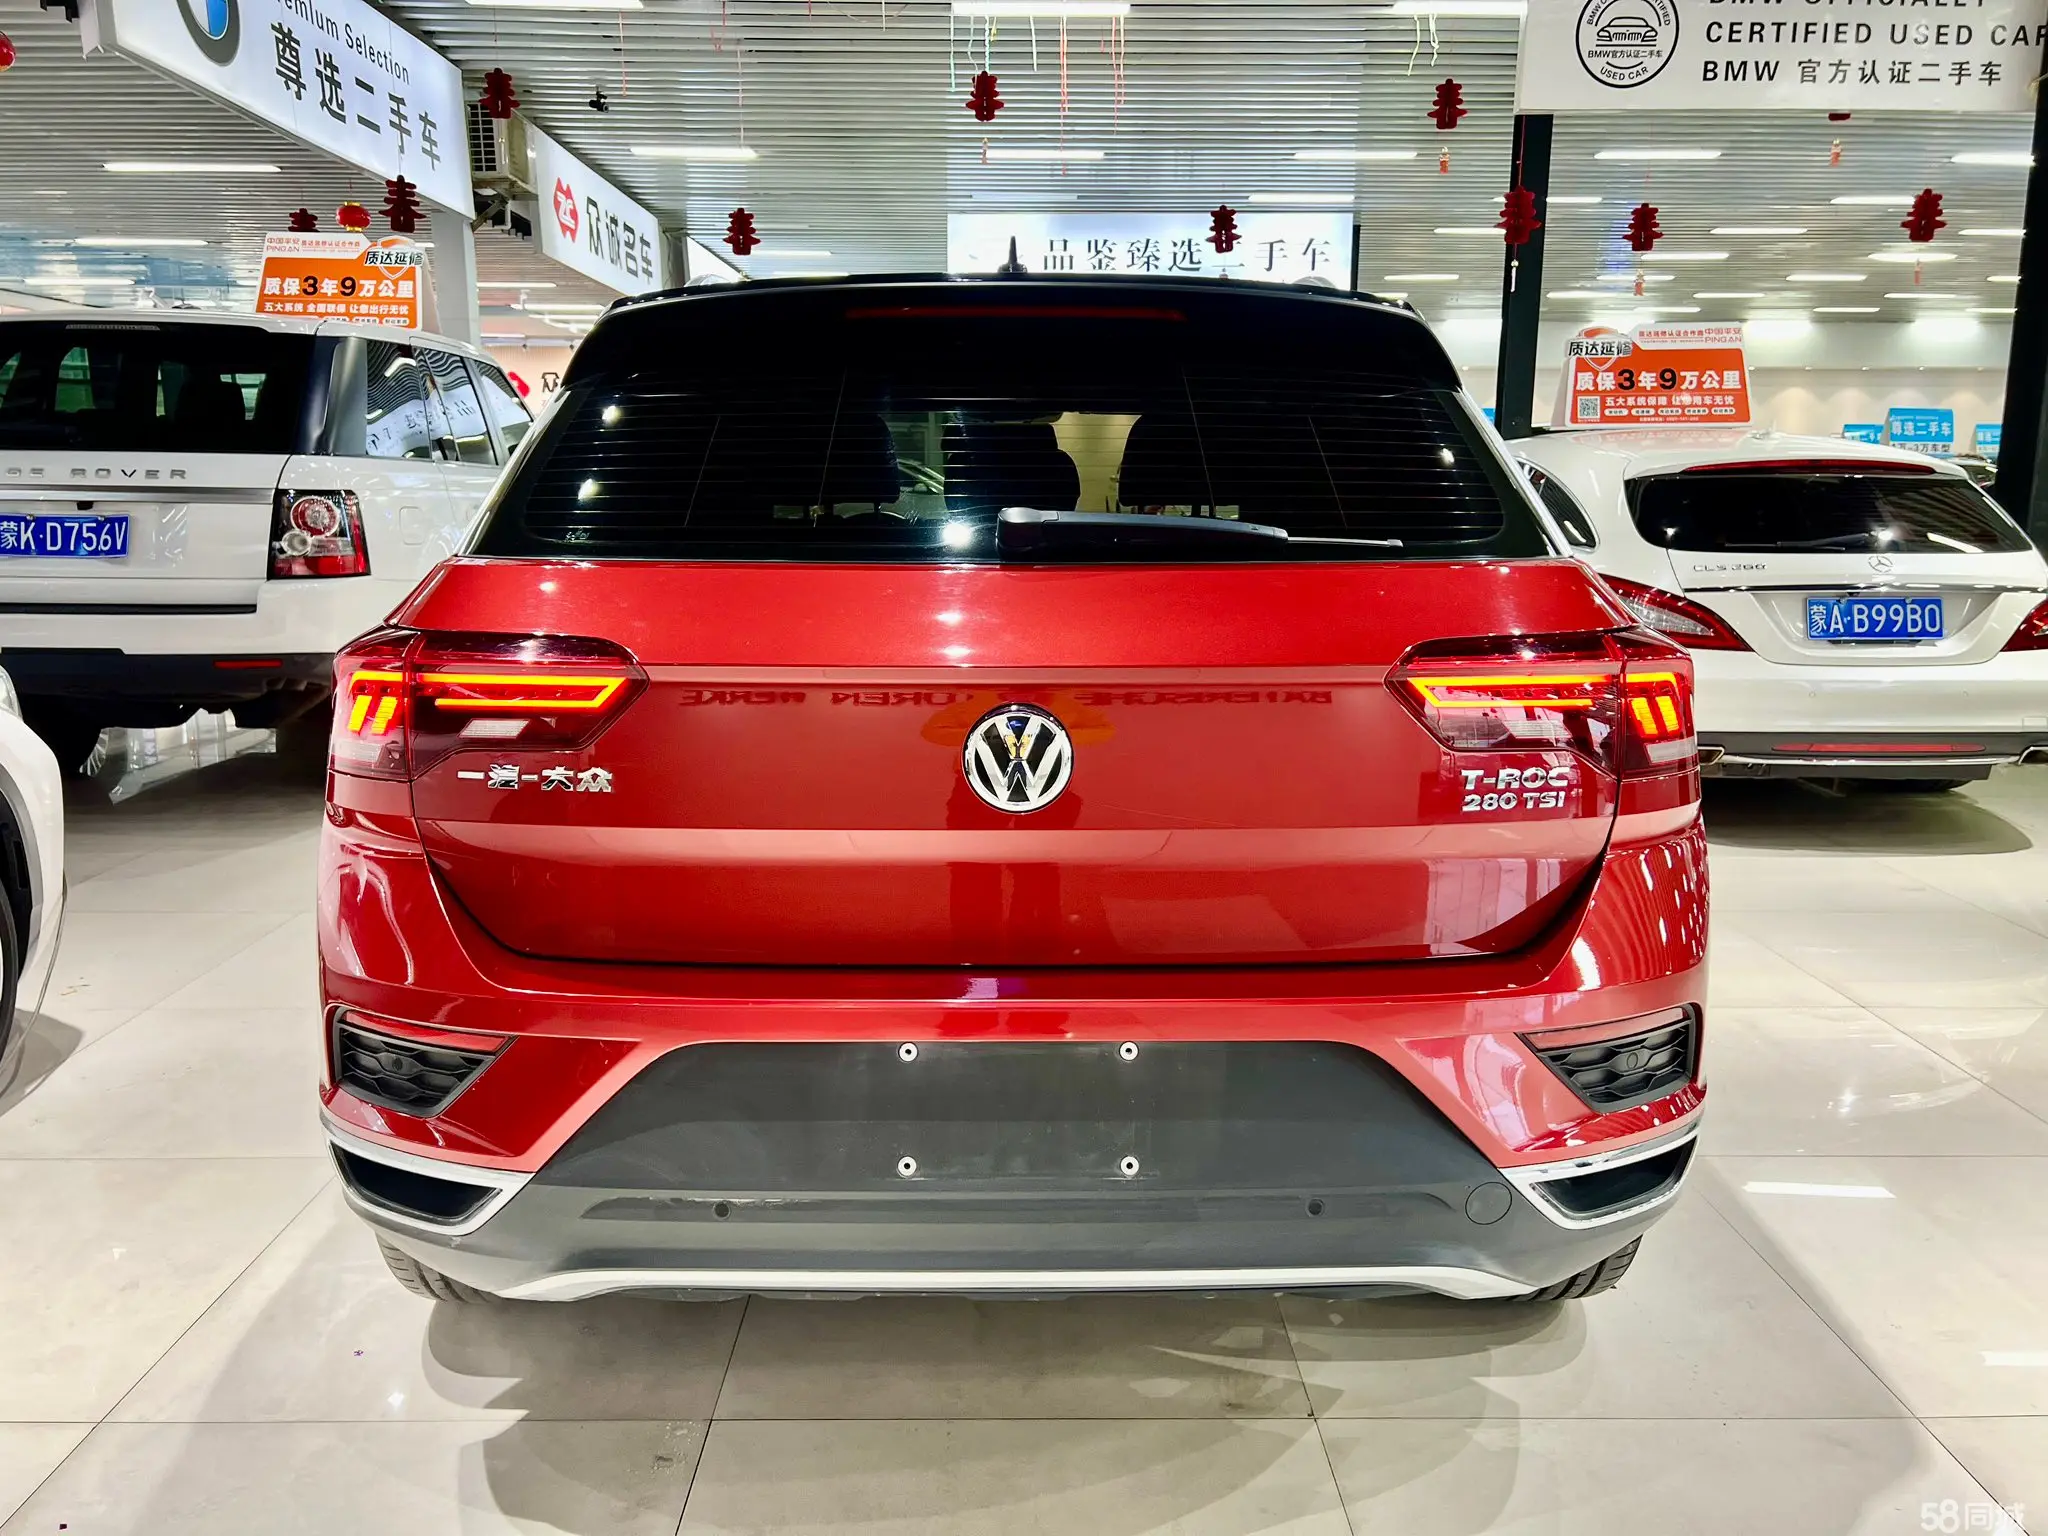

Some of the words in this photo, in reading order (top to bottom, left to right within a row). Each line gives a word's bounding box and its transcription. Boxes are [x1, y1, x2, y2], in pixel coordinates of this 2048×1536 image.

[278, 0, 339, 40] emium
[345, 23, 410, 85] Selection
[1705, 21, 1872, 44] CERTIFIED
[1889, 23, 1974, 45] USED
[1600, 66, 1625, 80] USED
[1628, 66, 1649, 80] CAR
[1702, 60, 1780, 82] BMW
[1797, 59, 2002, 86] 官方认证二手车
[271, 22, 441, 171] 尊选二手车
[586, 196, 654, 285] 众诚名车
[364, 251, 423, 266] 质达延修
[1043, 237, 1330, 273] 品鉴臻选二手车
[264, 276, 414, 299] 质保3年9万公里
[1568, 341, 1632, 356] 质达延修
[1576, 368, 1742, 391] 质保3年9万公里
[70, 468, 187, 479] ROVER
[457, 763, 613, 793] 一汽-大众
[1461, 766, 1571, 790] T-ROC
[1462, 791, 1518, 812] 280
[1522, 790, 1566, 809] TSI
